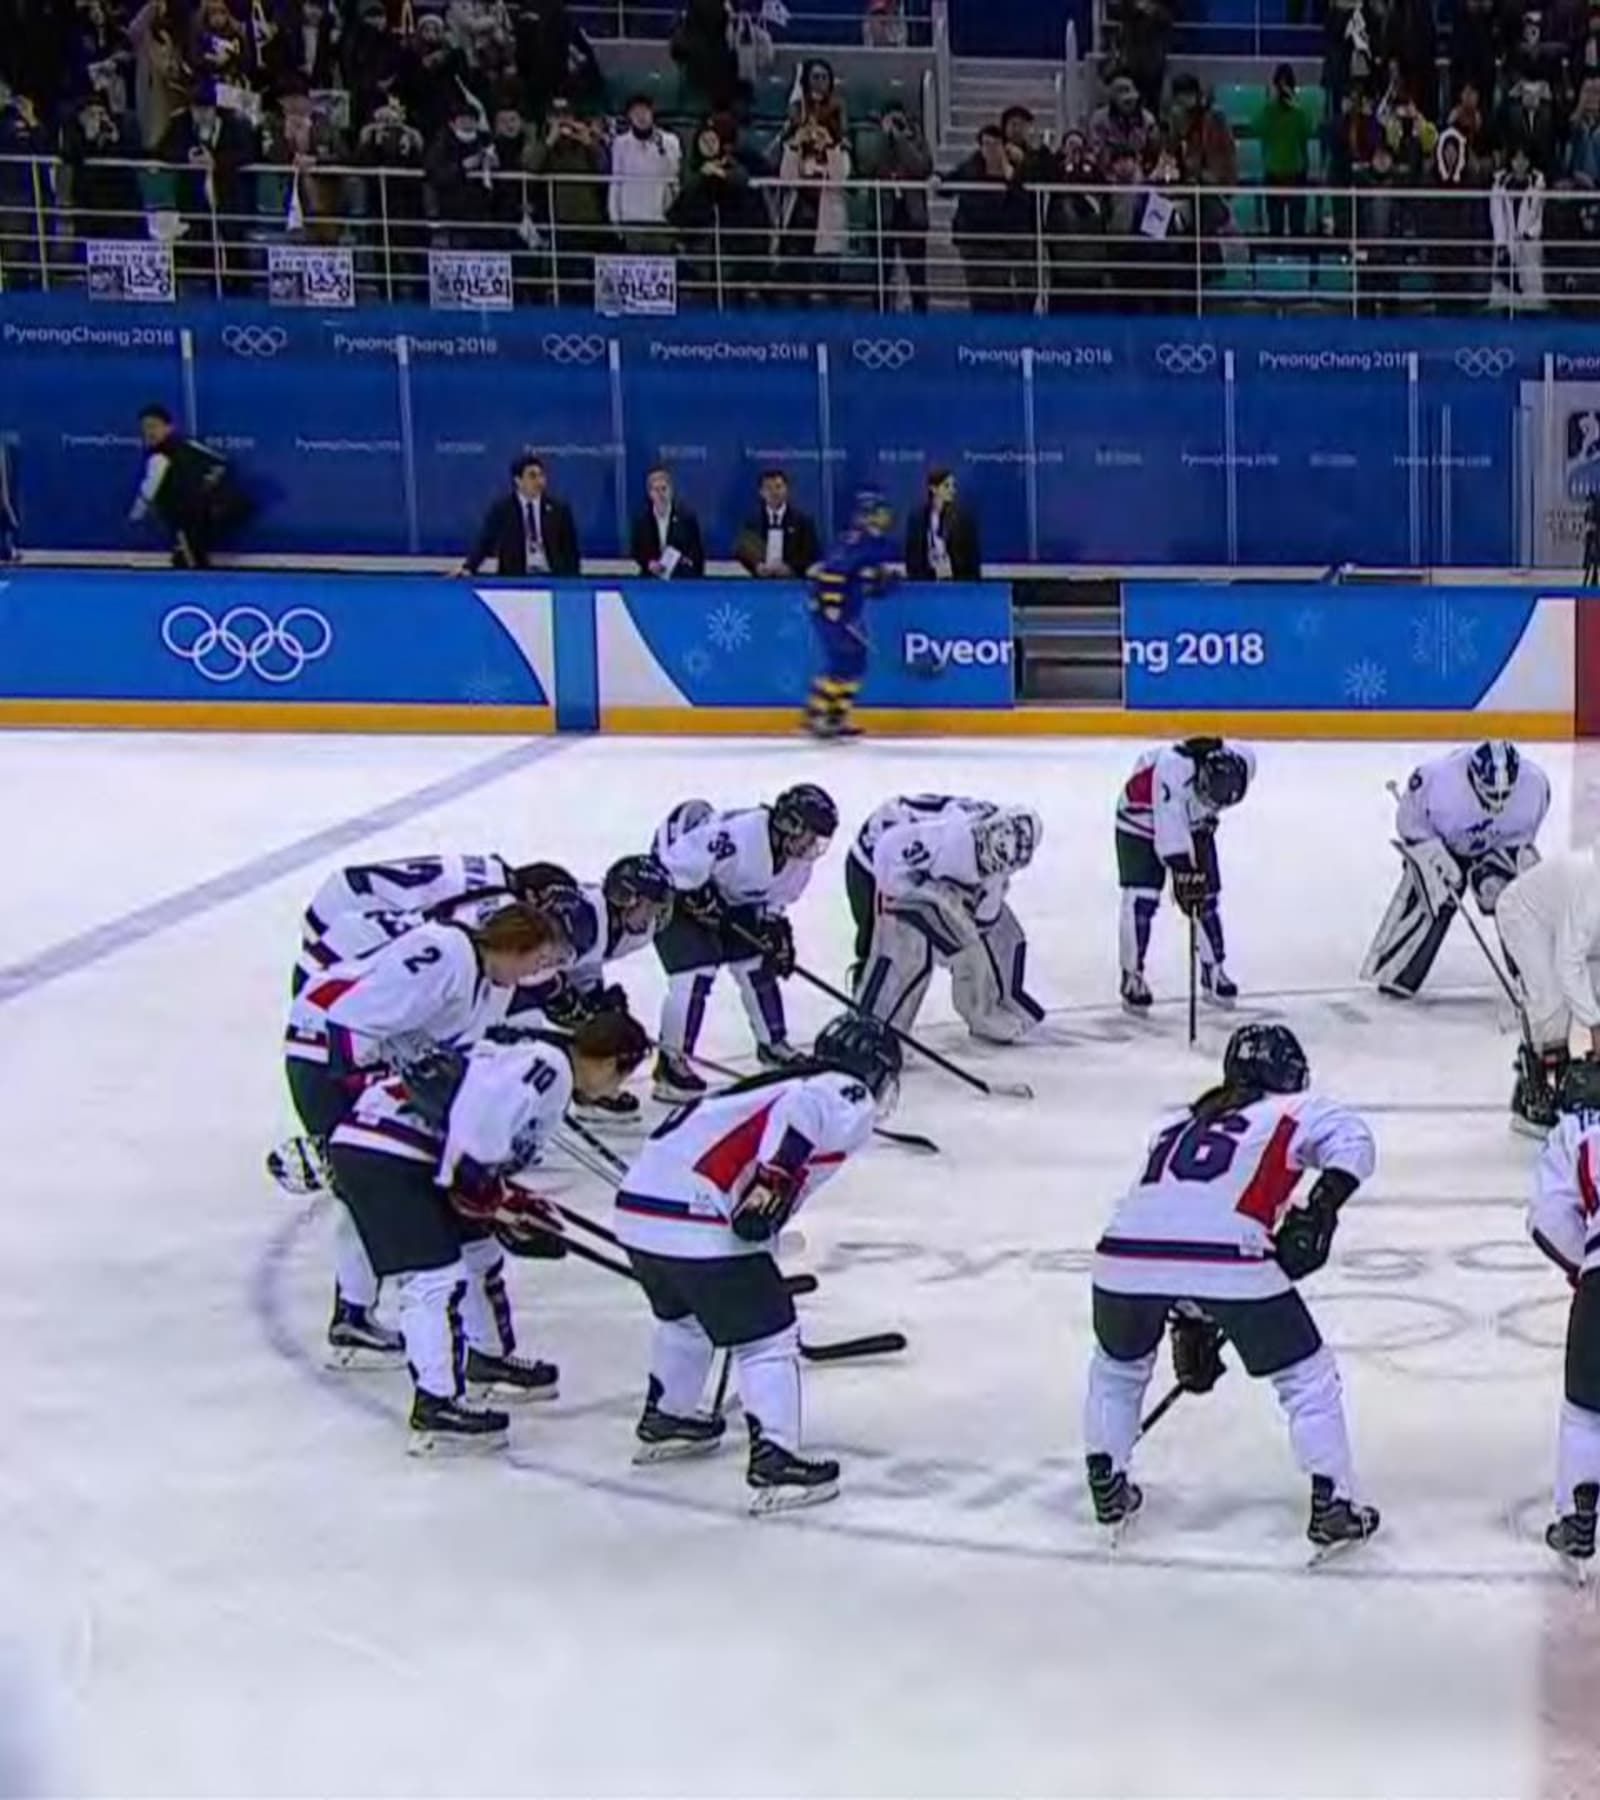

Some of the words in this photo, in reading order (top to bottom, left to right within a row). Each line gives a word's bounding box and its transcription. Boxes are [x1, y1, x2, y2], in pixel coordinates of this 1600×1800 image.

[3, 324, 131, 347] PyeongChang
[132, 330, 175, 346] 2018
[456, 337, 498, 353] 2018
[650, 341, 766, 361] PyeongChang
[769, 344, 808, 359] 2018
[958, 345, 1072, 366] Pyeonghang
[1075, 348, 1113, 364] 2018
[1258, 351, 1371, 371] PyeongChang
[1175, 632, 1265, 667] 2018
[403, 946, 442, 975] 2
[521, 1055, 559, 1097] 10
[1140, 1113, 1252, 1188] 16
